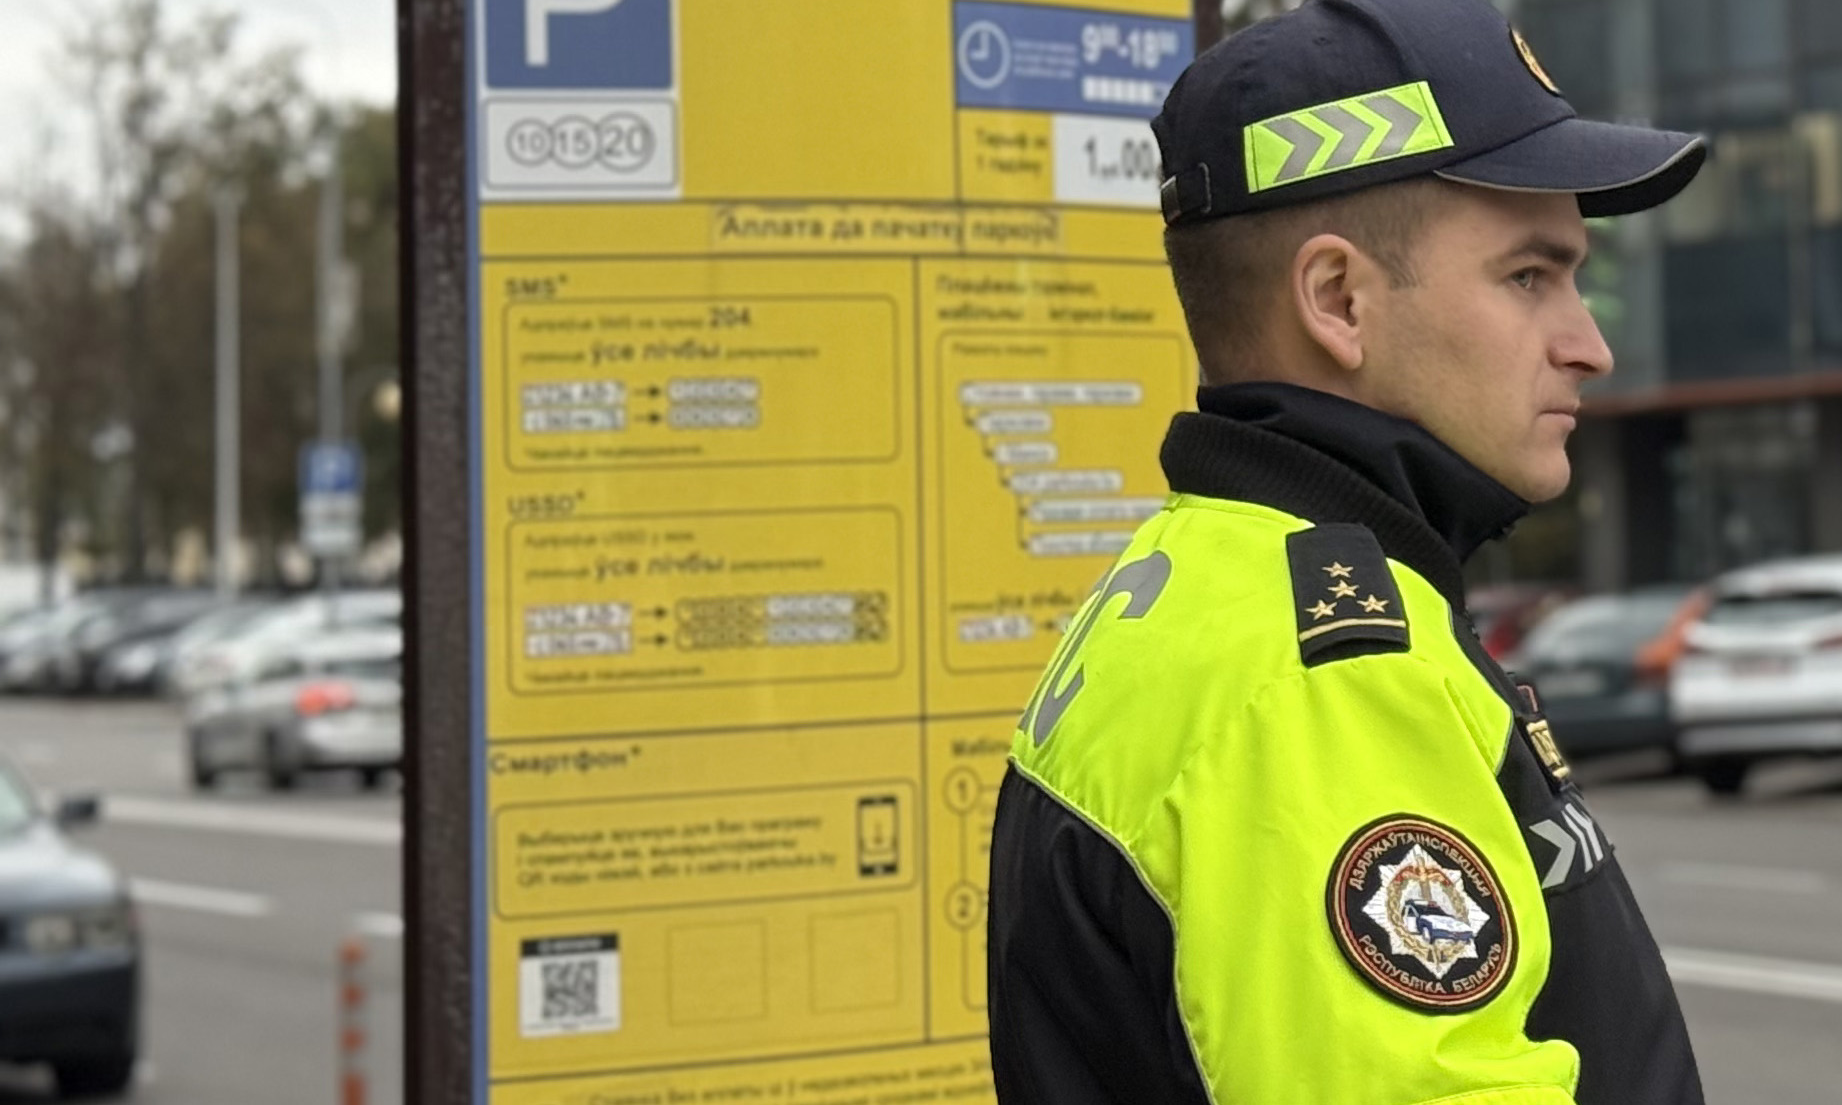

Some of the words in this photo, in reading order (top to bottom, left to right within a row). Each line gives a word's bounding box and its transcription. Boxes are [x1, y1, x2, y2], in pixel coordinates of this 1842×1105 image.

[517, 130, 546, 154] 10
[559, 128, 592, 156] 15
[605, 124, 644, 157] 20
[722, 214, 824, 240] Аплата
[1018, 550, 1172, 748] С
[1358, 934, 1448, 994] РЭСПУБЛІКА
[1451, 943, 1502, 993] БЕЛАРУСЬ
